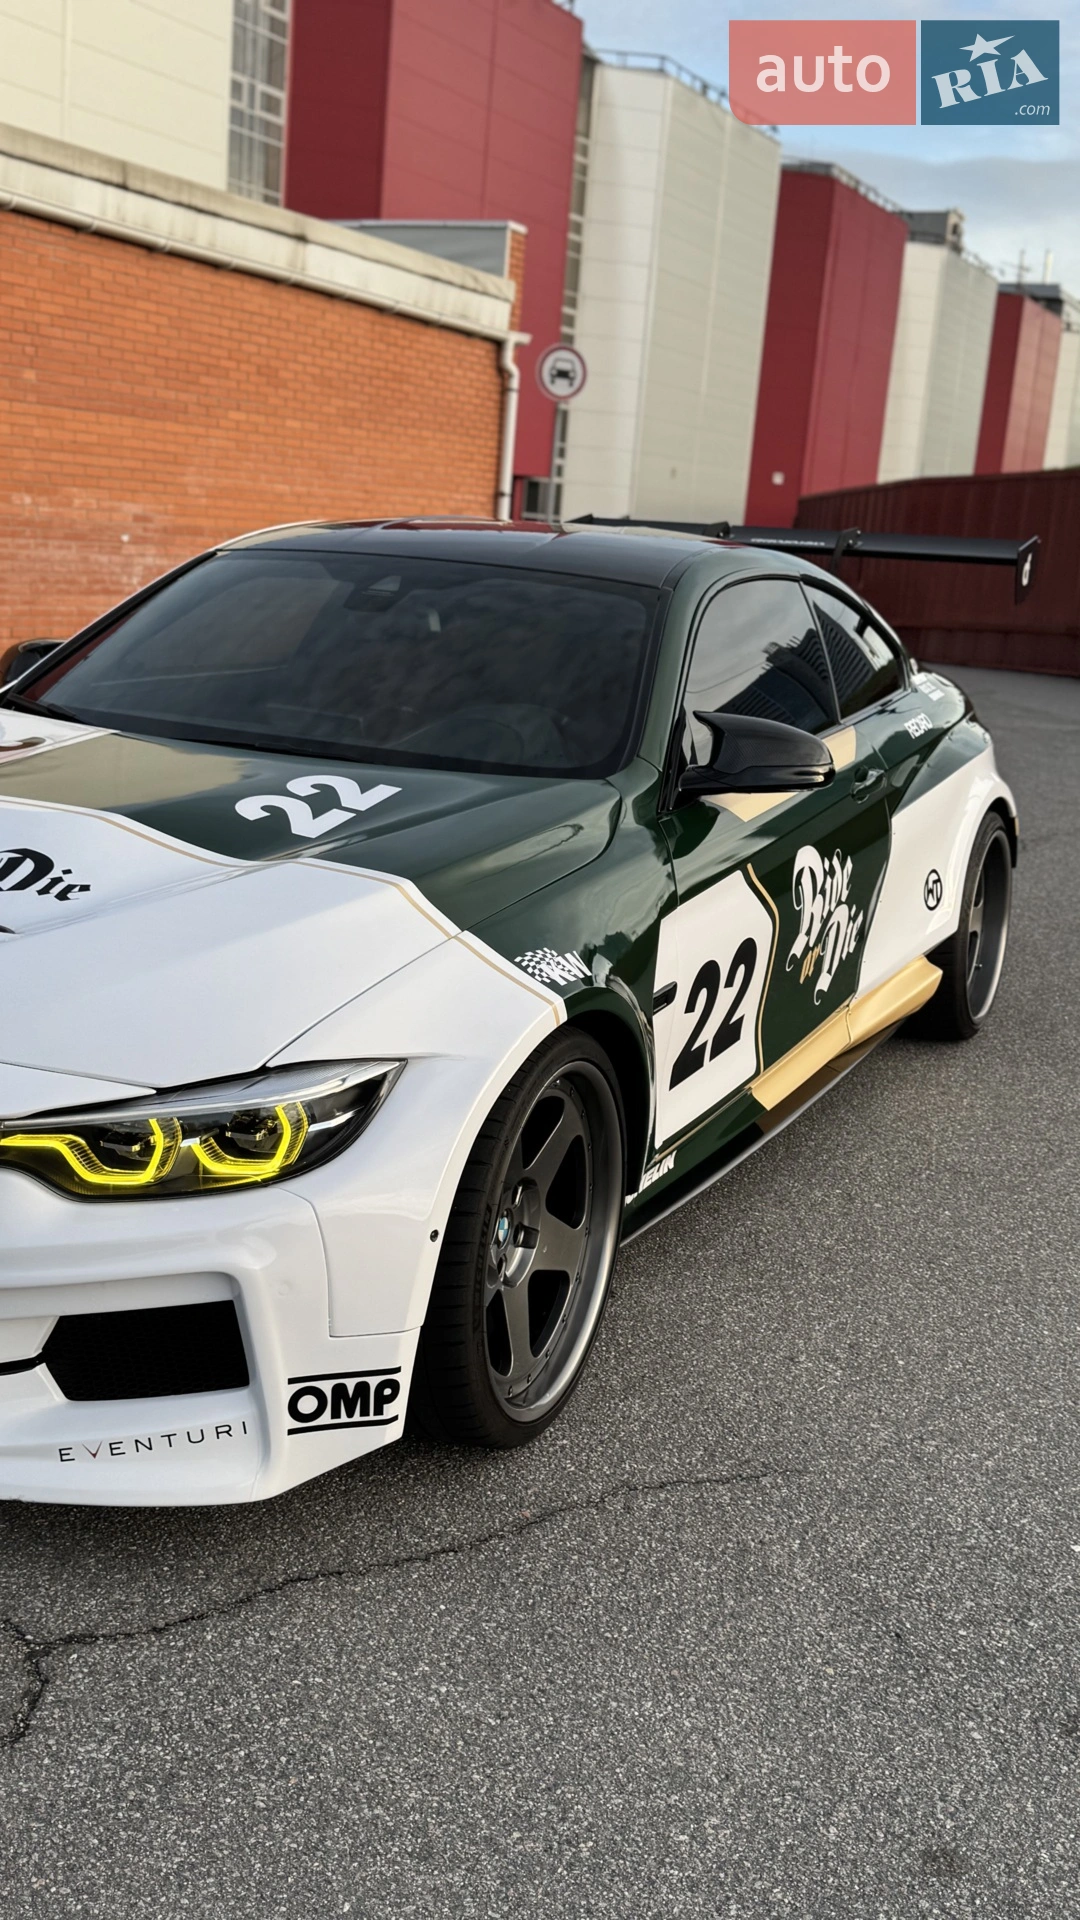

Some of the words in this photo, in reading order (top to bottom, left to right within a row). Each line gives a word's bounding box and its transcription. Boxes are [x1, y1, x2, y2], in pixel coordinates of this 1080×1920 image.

[235, 775, 402, 838] 22
[786, 845, 853, 972] Ride
[814, 904, 864, 1006] Die
[669, 937, 757, 1091] 22
[58, 1421, 248, 1463] EVENTURI
[287, 1378, 401, 1424] OMP
